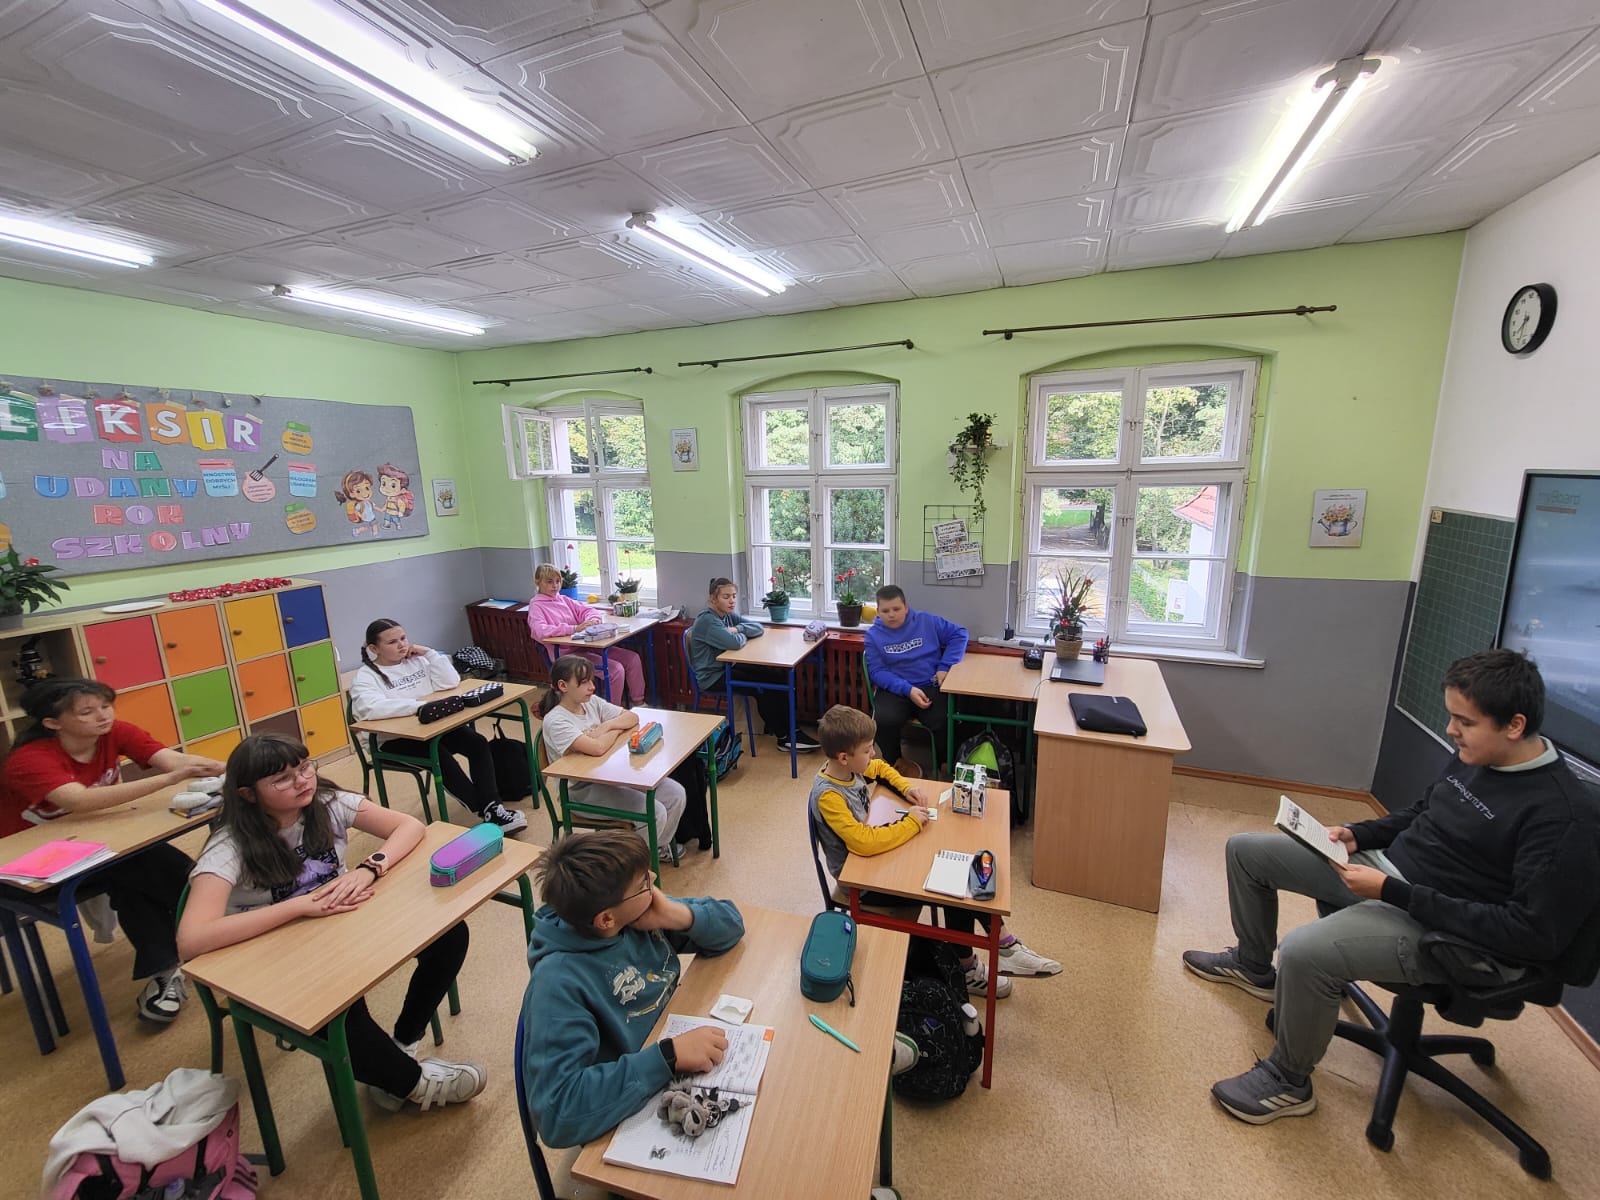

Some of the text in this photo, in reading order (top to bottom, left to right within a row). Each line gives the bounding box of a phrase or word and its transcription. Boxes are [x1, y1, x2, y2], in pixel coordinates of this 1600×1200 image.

[101, 448, 162, 471] NA
[34, 475, 197, 498] UDANY
[92, 503, 183, 524] ROK
[51, 522, 250, 558] SZKOLNY
